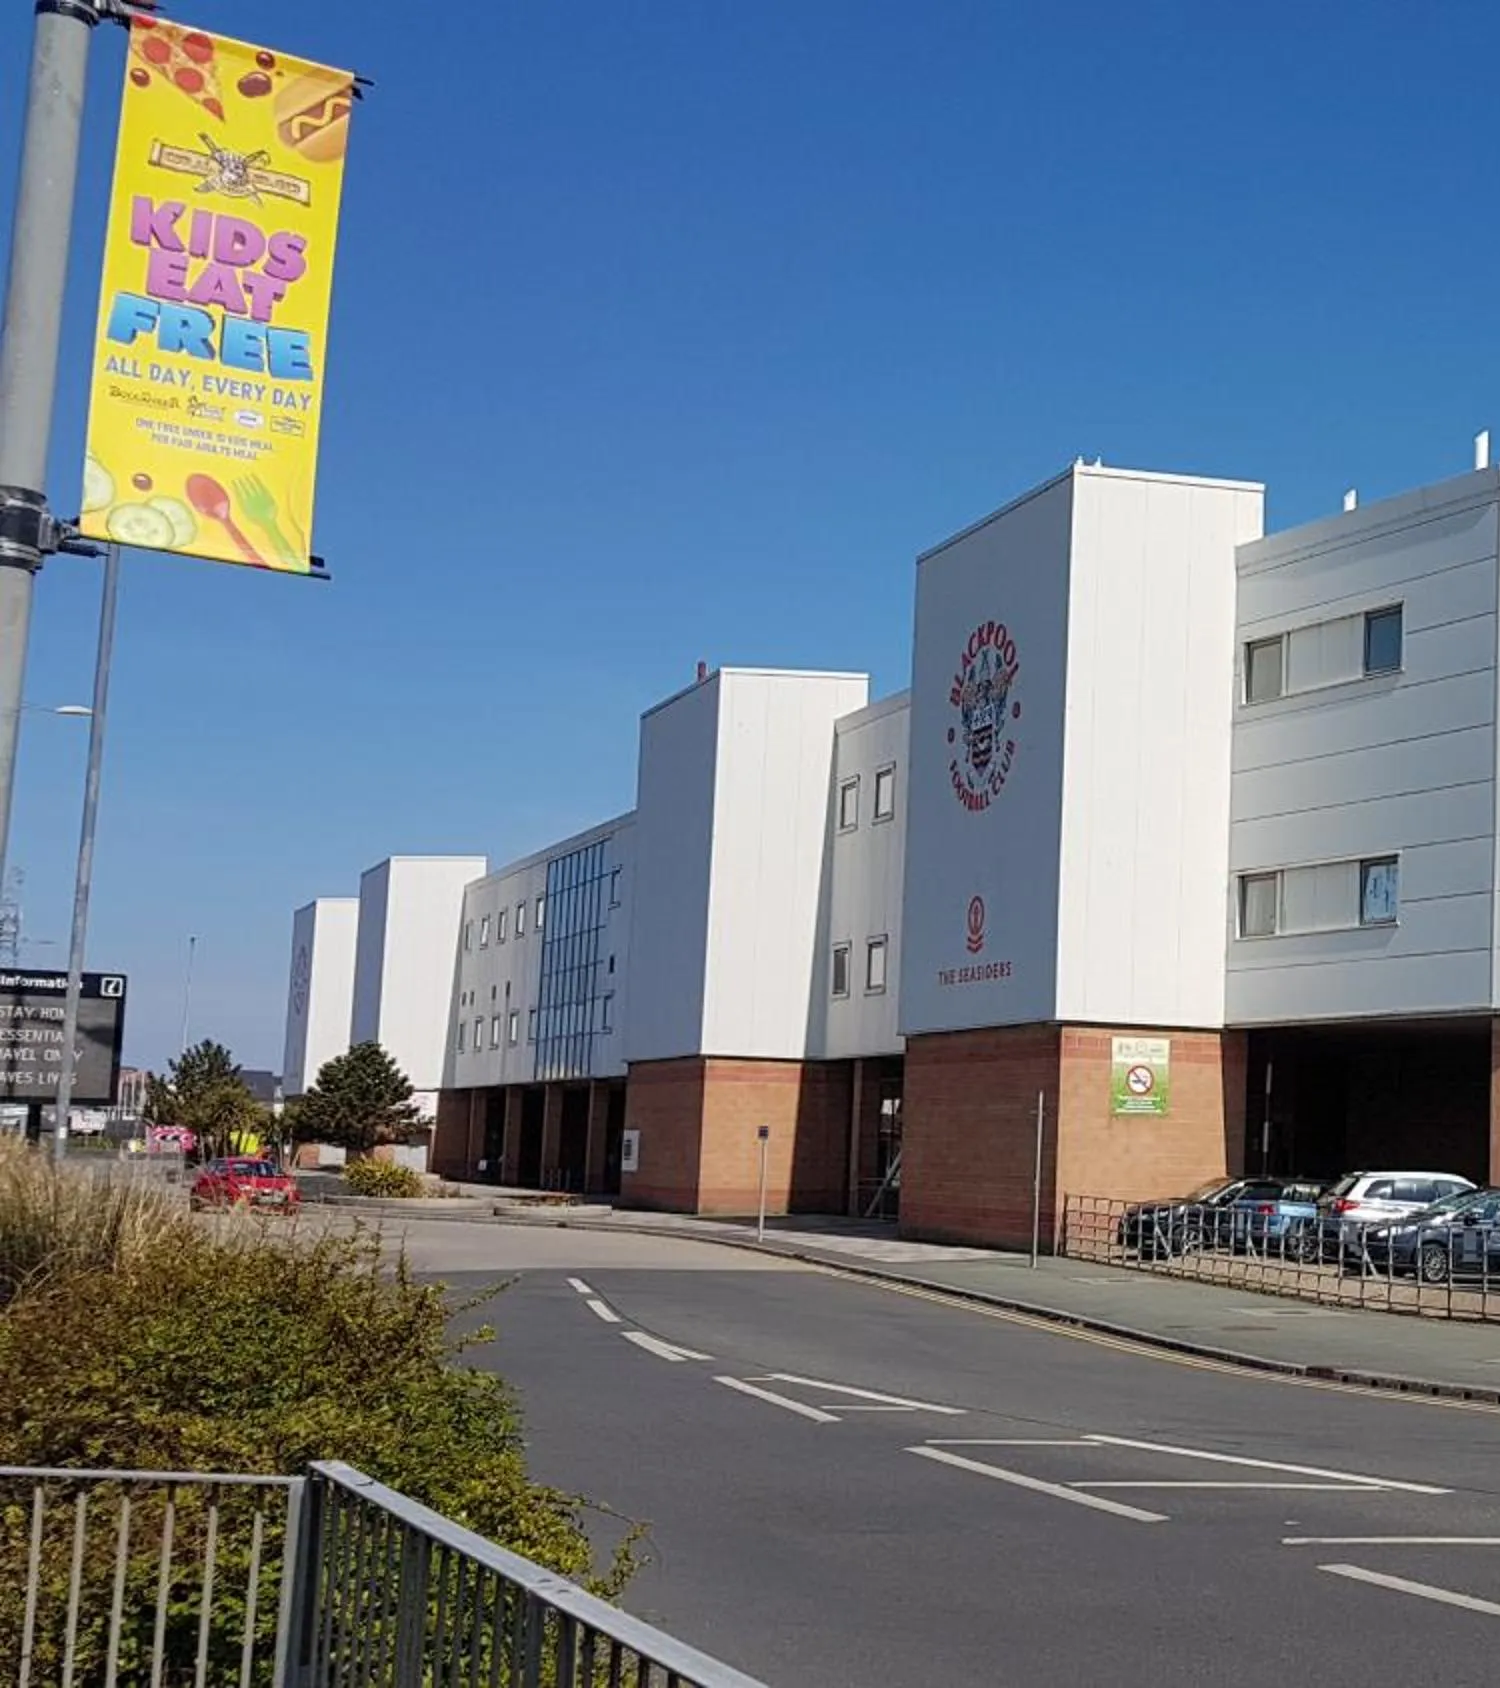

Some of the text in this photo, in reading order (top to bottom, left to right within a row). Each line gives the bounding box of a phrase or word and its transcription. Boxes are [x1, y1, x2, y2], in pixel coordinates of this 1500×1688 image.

[130, 195, 308, 283] KIDS
[146, 250, 286, 323] EAT
[105, 290, 314, 382] FREE
[104, 354, 142, 380] ALL
[149, 362, 196, 392] DAY,
[201, 374, 267, 403] EVERY
[270, 387, 314, 412] DAY
[938, 968, 956, 986] THE
[0, 1029, 65, 1042] ESSENTIA
[39, 1072, 77, 1086] LIVS
